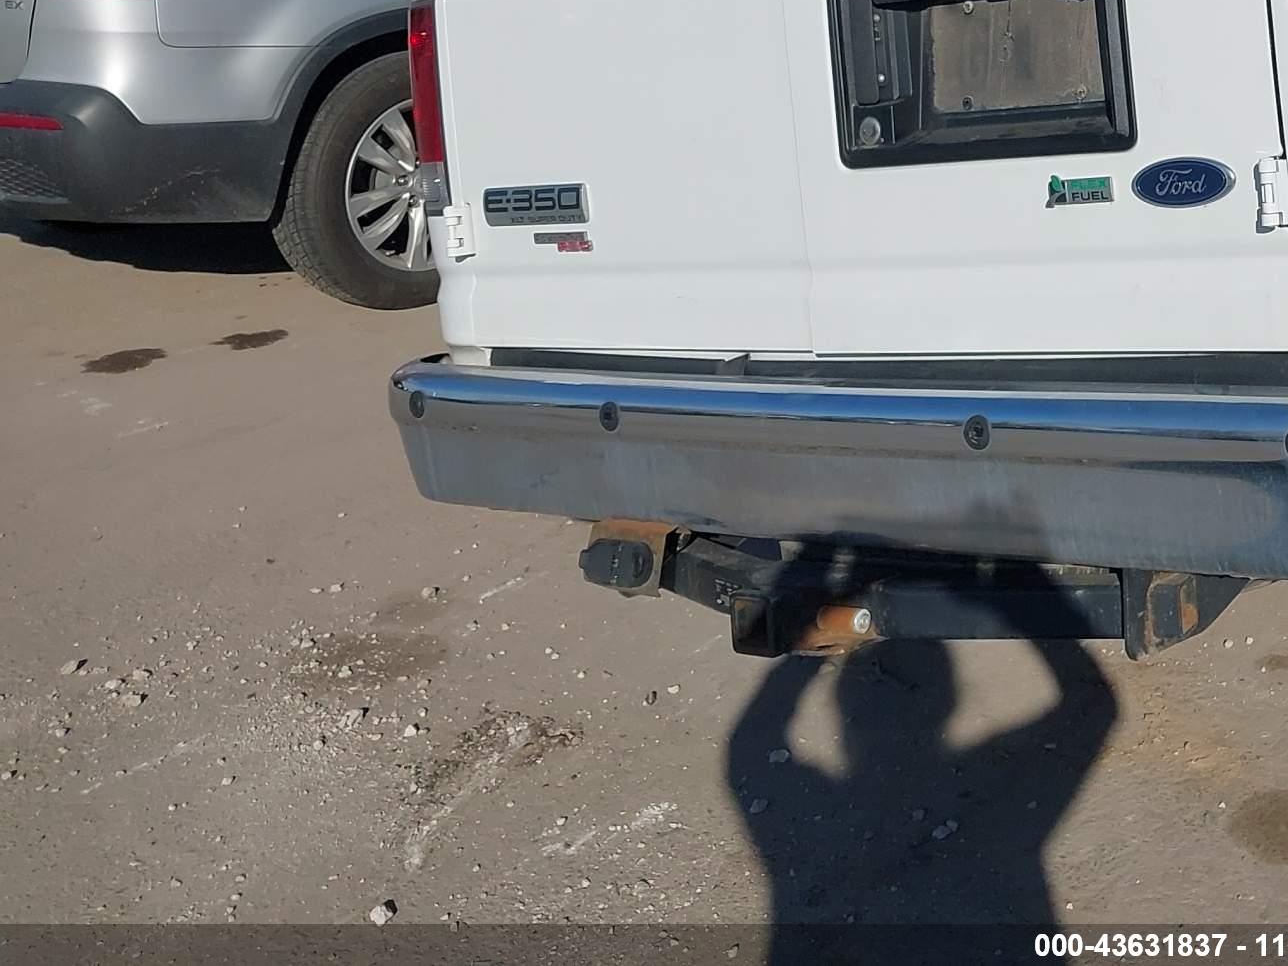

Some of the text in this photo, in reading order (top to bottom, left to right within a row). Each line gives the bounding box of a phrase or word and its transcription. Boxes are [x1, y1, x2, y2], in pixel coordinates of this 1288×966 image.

[5, 0, 23, 10] EX
[1156, 168, 1207, 196] Ford
[485, 186, 580, 213] E-350
[1071, 190, 1109, 202] FUEL
